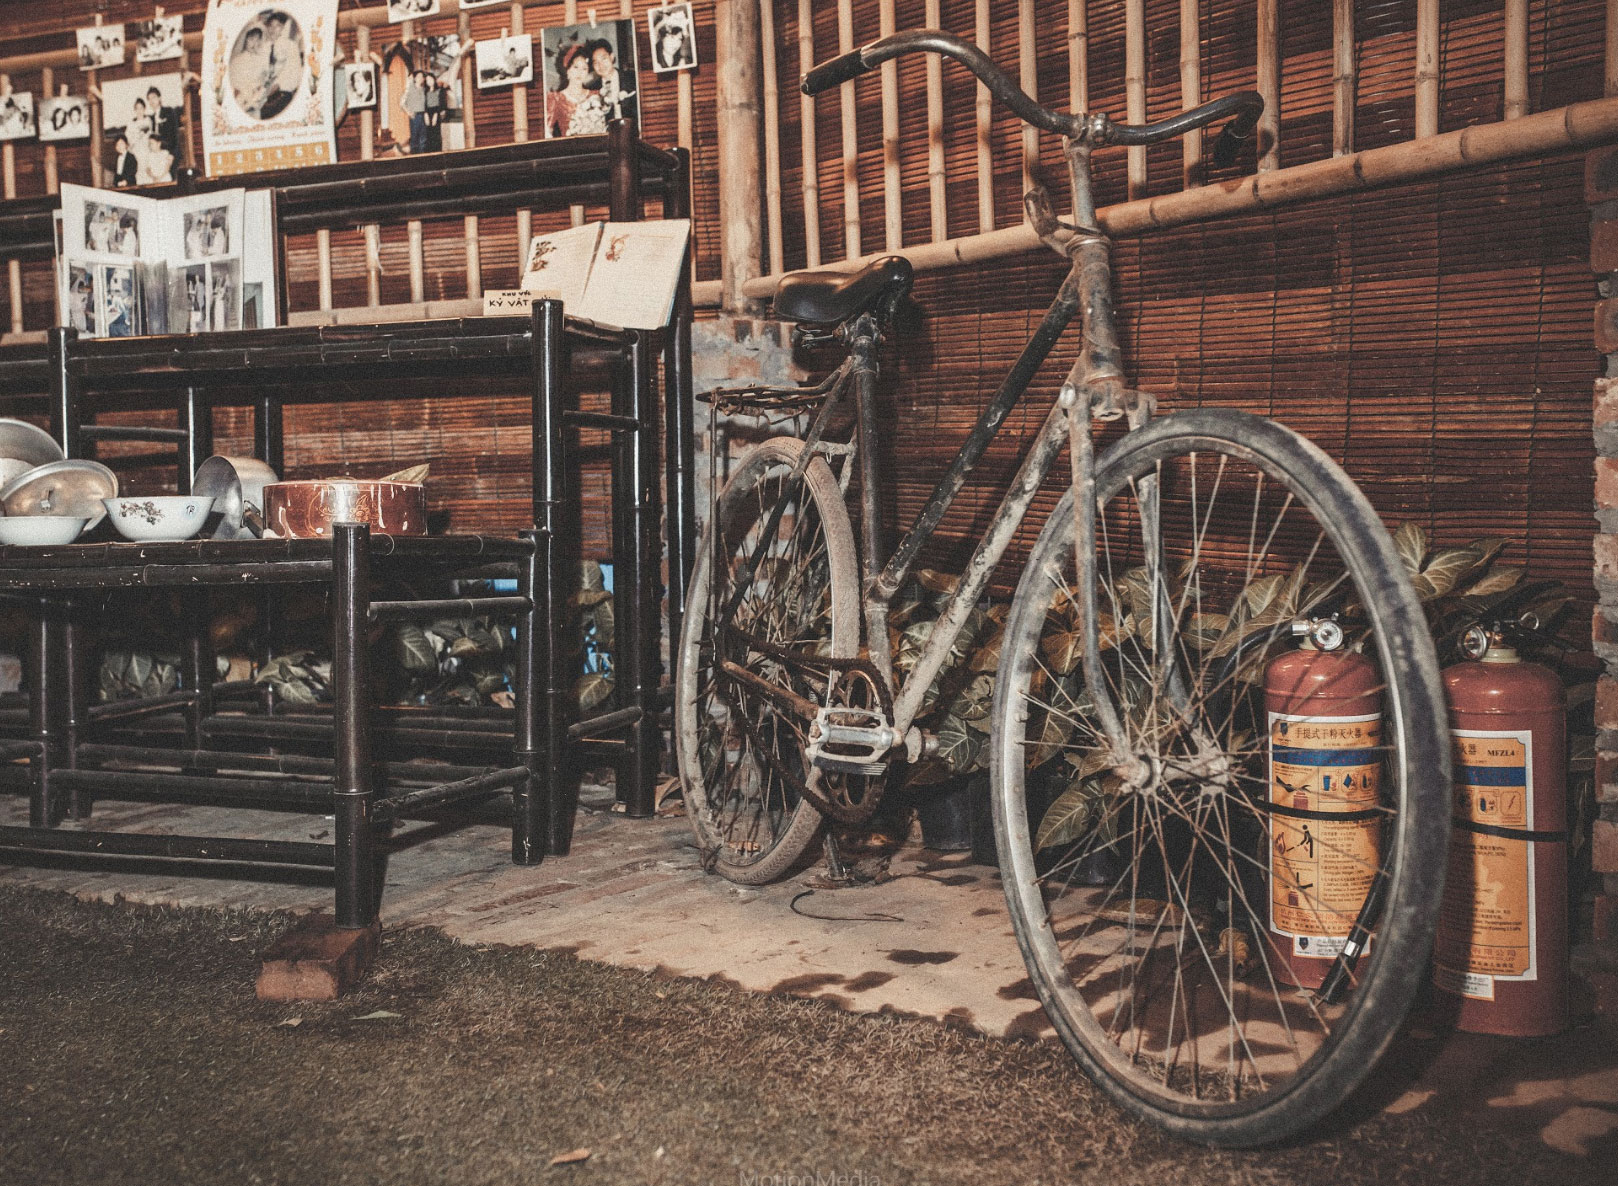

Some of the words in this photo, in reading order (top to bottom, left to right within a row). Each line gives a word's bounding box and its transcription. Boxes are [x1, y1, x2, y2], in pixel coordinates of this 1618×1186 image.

[1296, 727, 1362, 739] 手提式干粉灭火器
